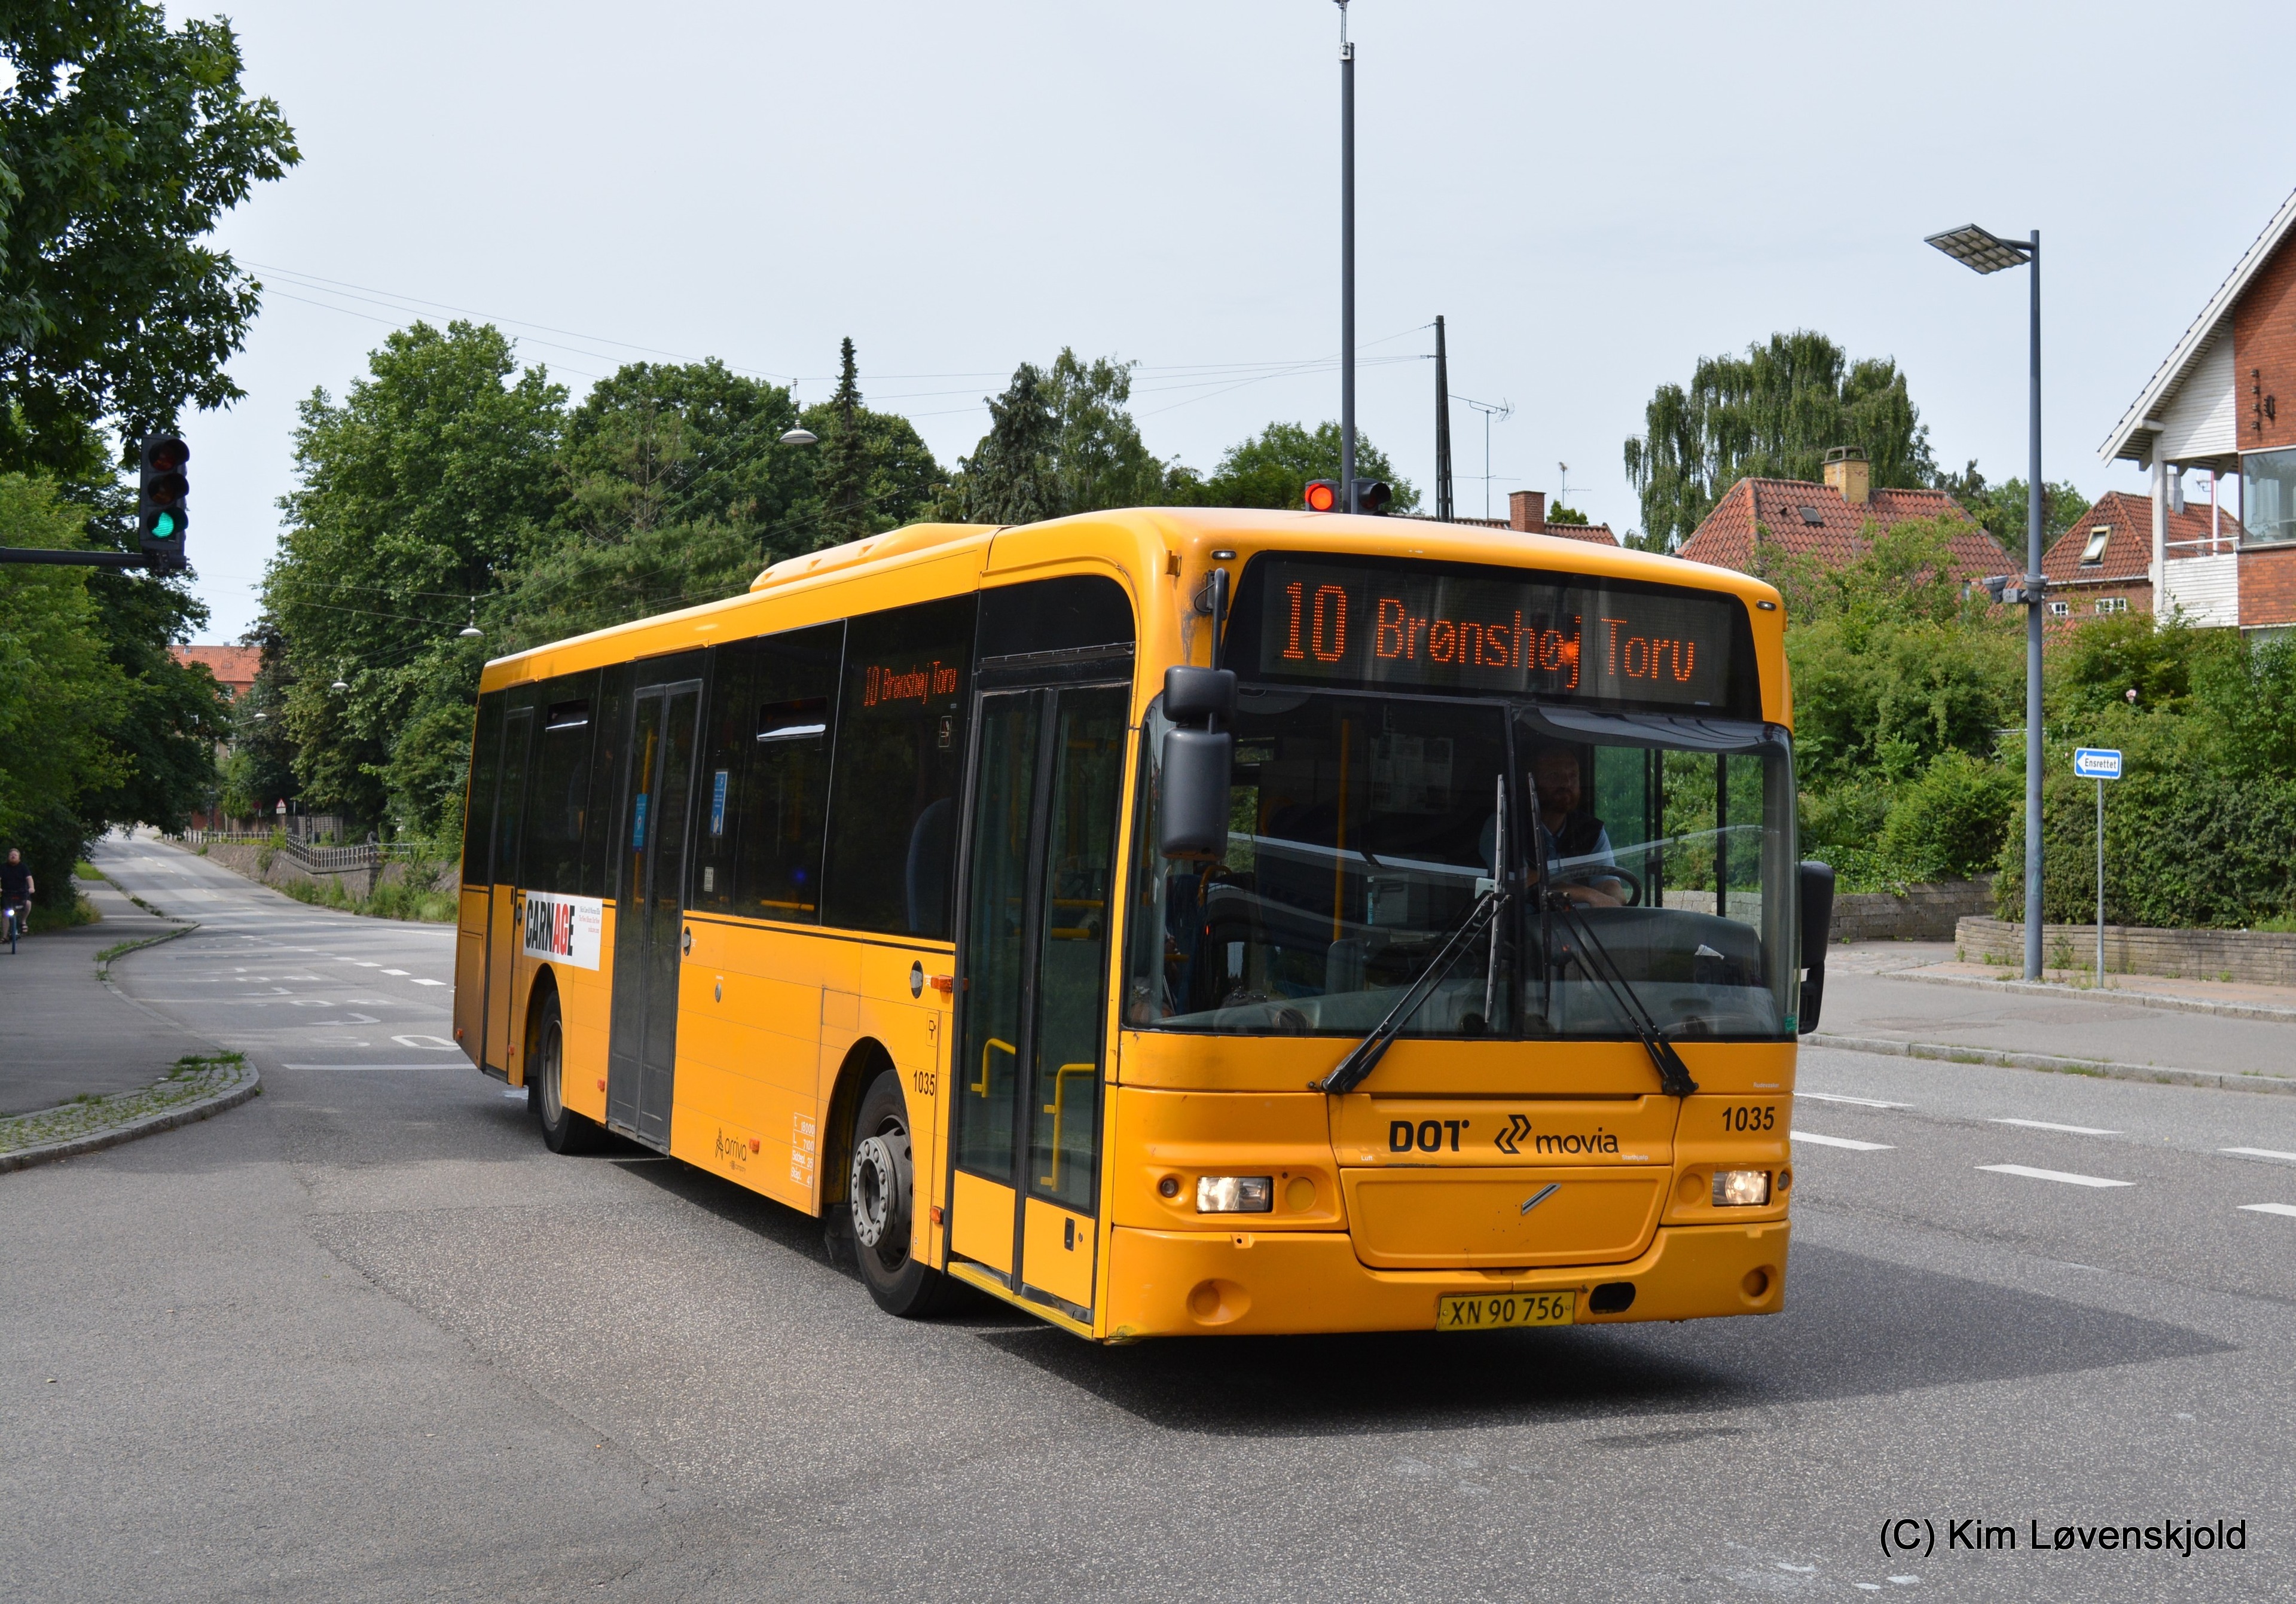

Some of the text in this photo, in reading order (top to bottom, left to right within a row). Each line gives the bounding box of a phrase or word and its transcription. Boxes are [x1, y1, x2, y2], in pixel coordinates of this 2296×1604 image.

[1283, 582, 1694, 688] 10 Brønshøj Torv
[864, 666, 880, 706] 10
[933, 661, 957, 694] Torv
[2085, 757, 2117, 769] Ensrettet
[526, 899, 575, 957] CARNAGE
[913, 1070, 935, 1096] 1035
[1722, 1106, 1775, 1132] 1035
[725, 1136, 747, 1162] arriva
[1389, 1120, 1470, 1153] DOT
[1535, 1127, 1619, 1154] movia
[806, 1175, 813, 1186] 41
[1449, 1296, 1564, 1325] XN 90 756
